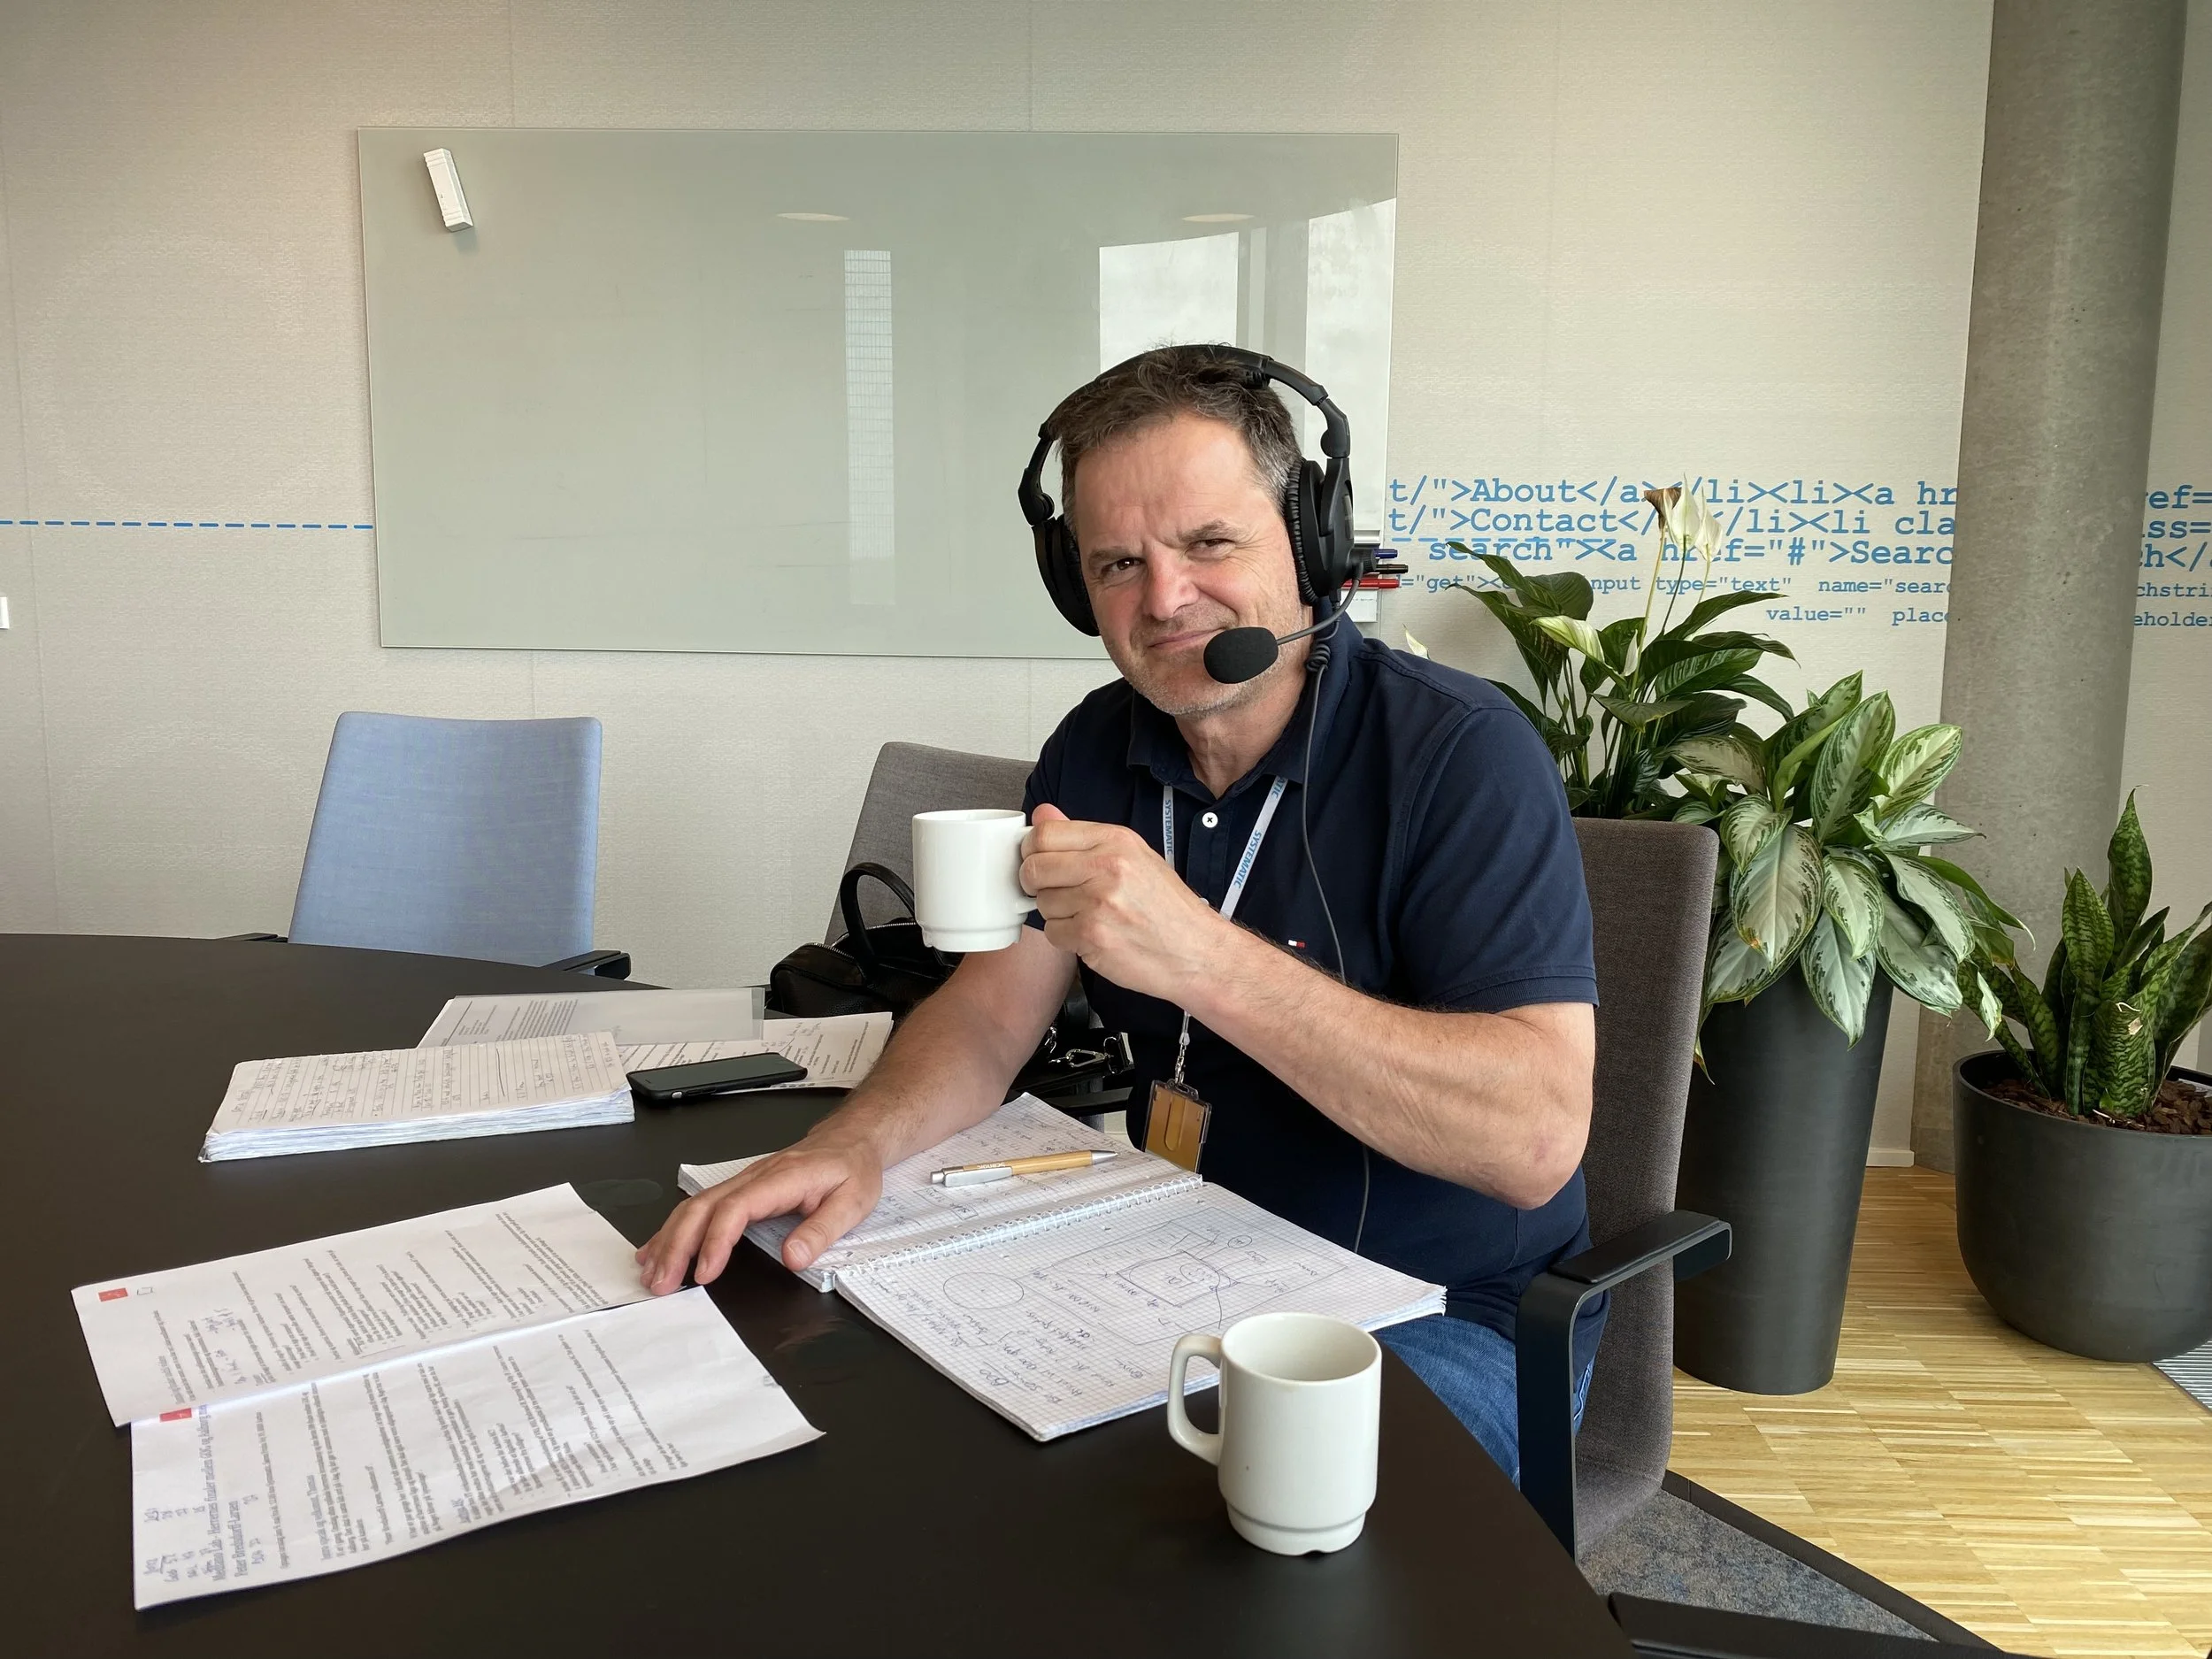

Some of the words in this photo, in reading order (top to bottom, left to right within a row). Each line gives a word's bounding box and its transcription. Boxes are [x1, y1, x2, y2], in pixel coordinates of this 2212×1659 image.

[2145, 484, 2212, 509] ef=
[2141, 520, 2212, 539] ss=
[1766, 606, 1866, 621] value=""
[1164, 799, 1174, 855] SYSTEMATIC
[1233, 830, 1262, 889] SYSTEMATIC
